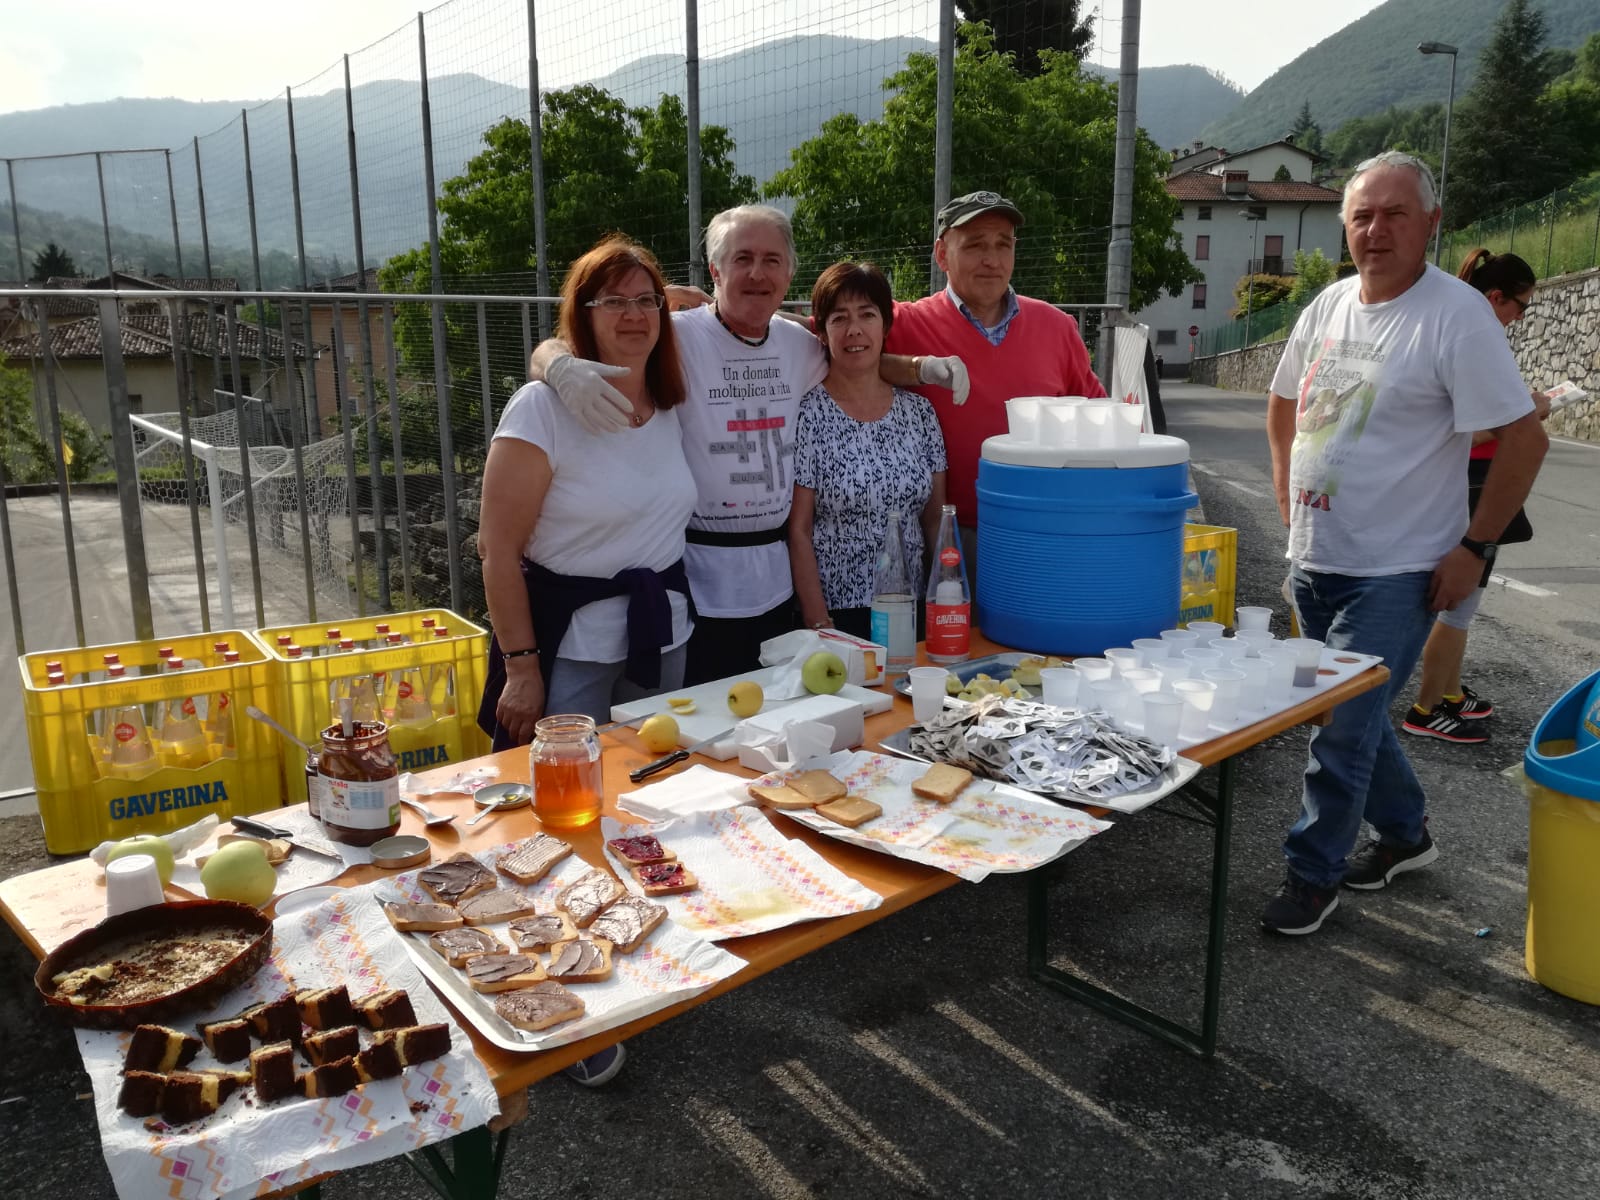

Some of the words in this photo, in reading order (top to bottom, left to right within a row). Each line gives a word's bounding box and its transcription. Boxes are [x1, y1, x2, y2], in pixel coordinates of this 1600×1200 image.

[722, 367, 739, 381] Un
[708, 383, 767, 401] moltiplica
[109, 780, 229, 821] GAVERINA
